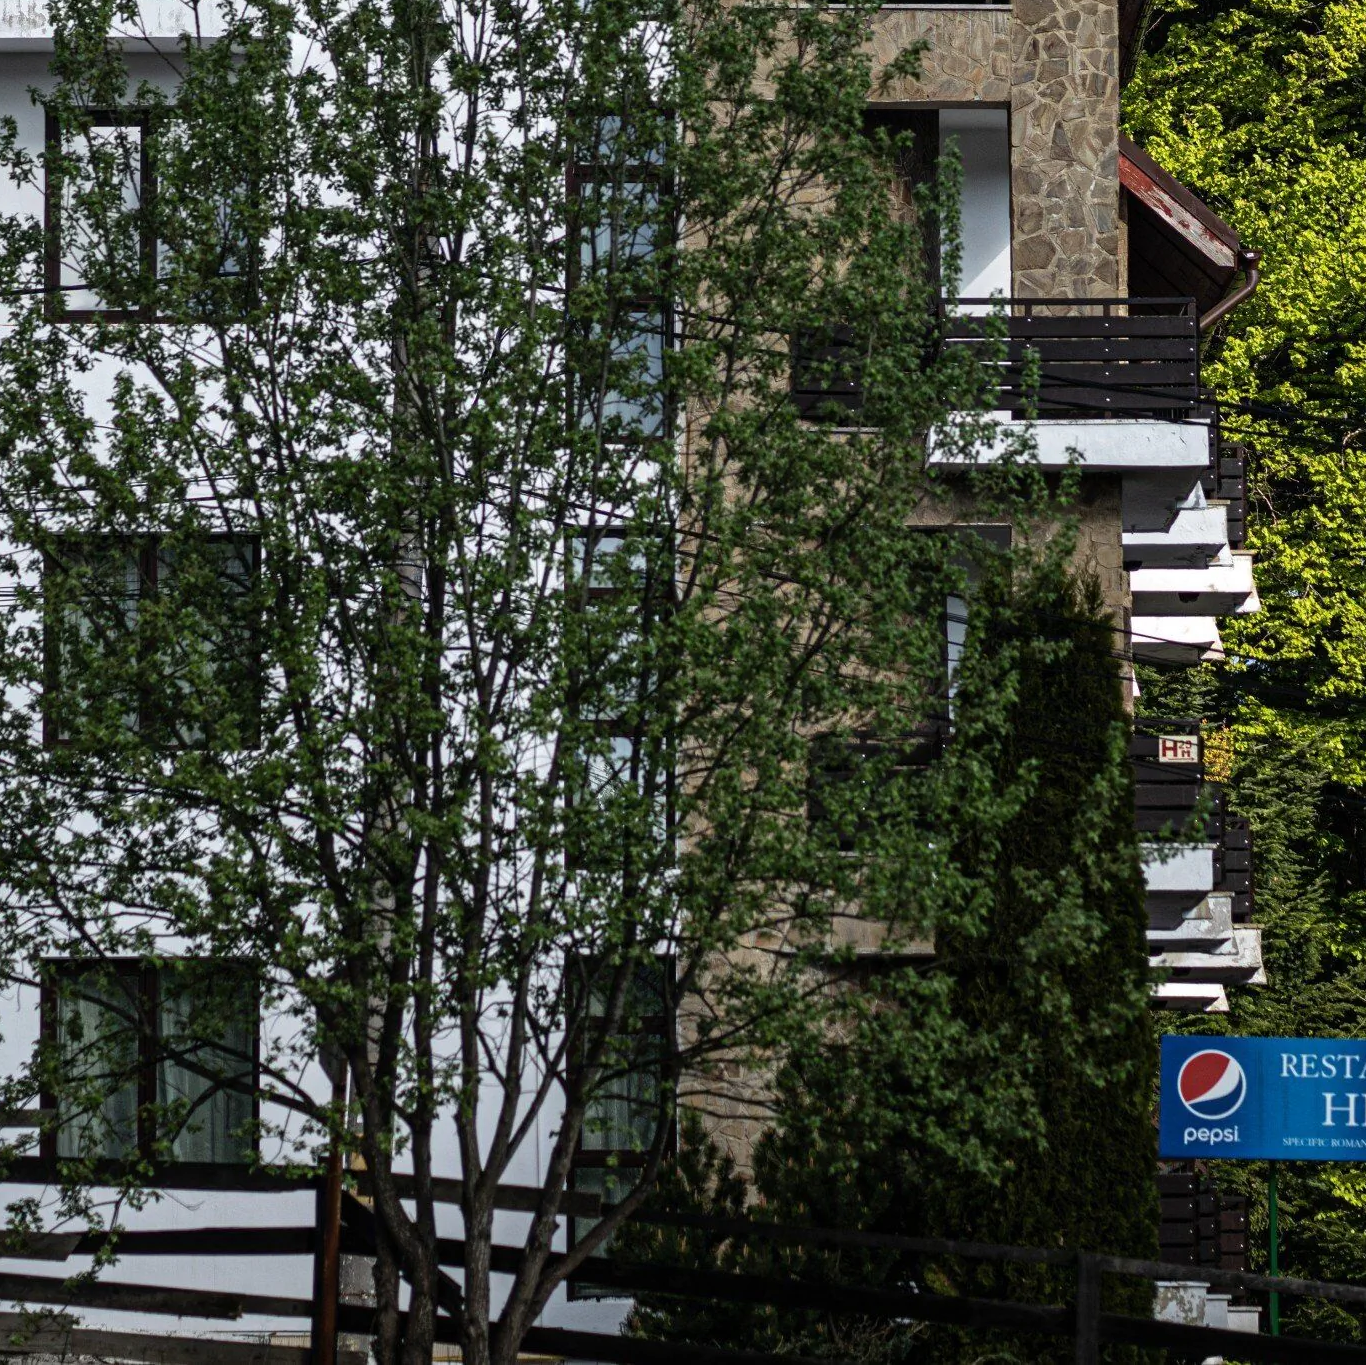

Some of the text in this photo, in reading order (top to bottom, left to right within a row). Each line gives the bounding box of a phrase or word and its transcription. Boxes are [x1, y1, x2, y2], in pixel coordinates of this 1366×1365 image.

[1162, 737, 1178, 757] H
[1183, 1125, 1239, 1146] pepsi
[1282, 1137, 1330, 1147] SPECIFIC
